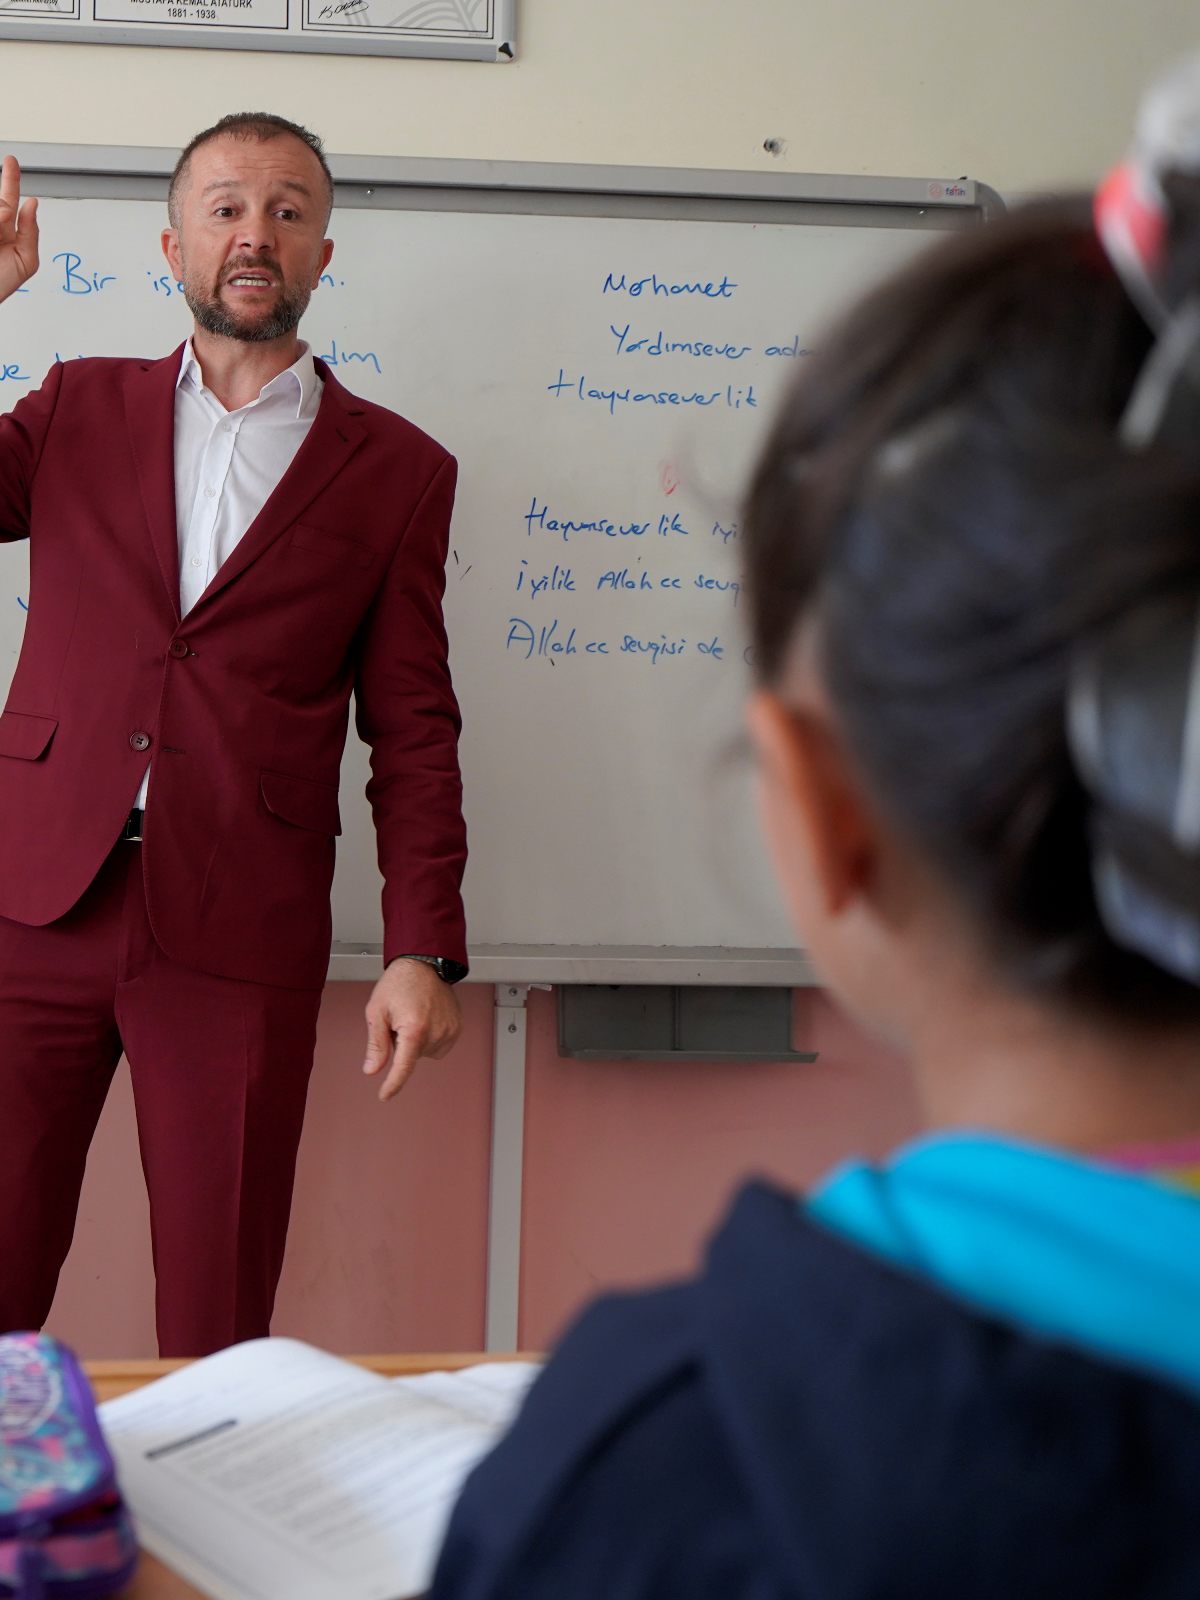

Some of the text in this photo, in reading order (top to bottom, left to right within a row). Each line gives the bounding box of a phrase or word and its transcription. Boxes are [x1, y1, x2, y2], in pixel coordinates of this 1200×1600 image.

[167, 8, 187, 18] 1881
[196, 9, 216, 19] 1938
[51, 250, 116, 297] Bir
[596, 569, 653, 590] Allah
[659, 577, 681, 589] cc
[504, 616, 578, 662] Allah
[585, 641, 607, 655] cc
[619, 633, 687, 666] sevgisi
[696, 636, 724, 661] de
